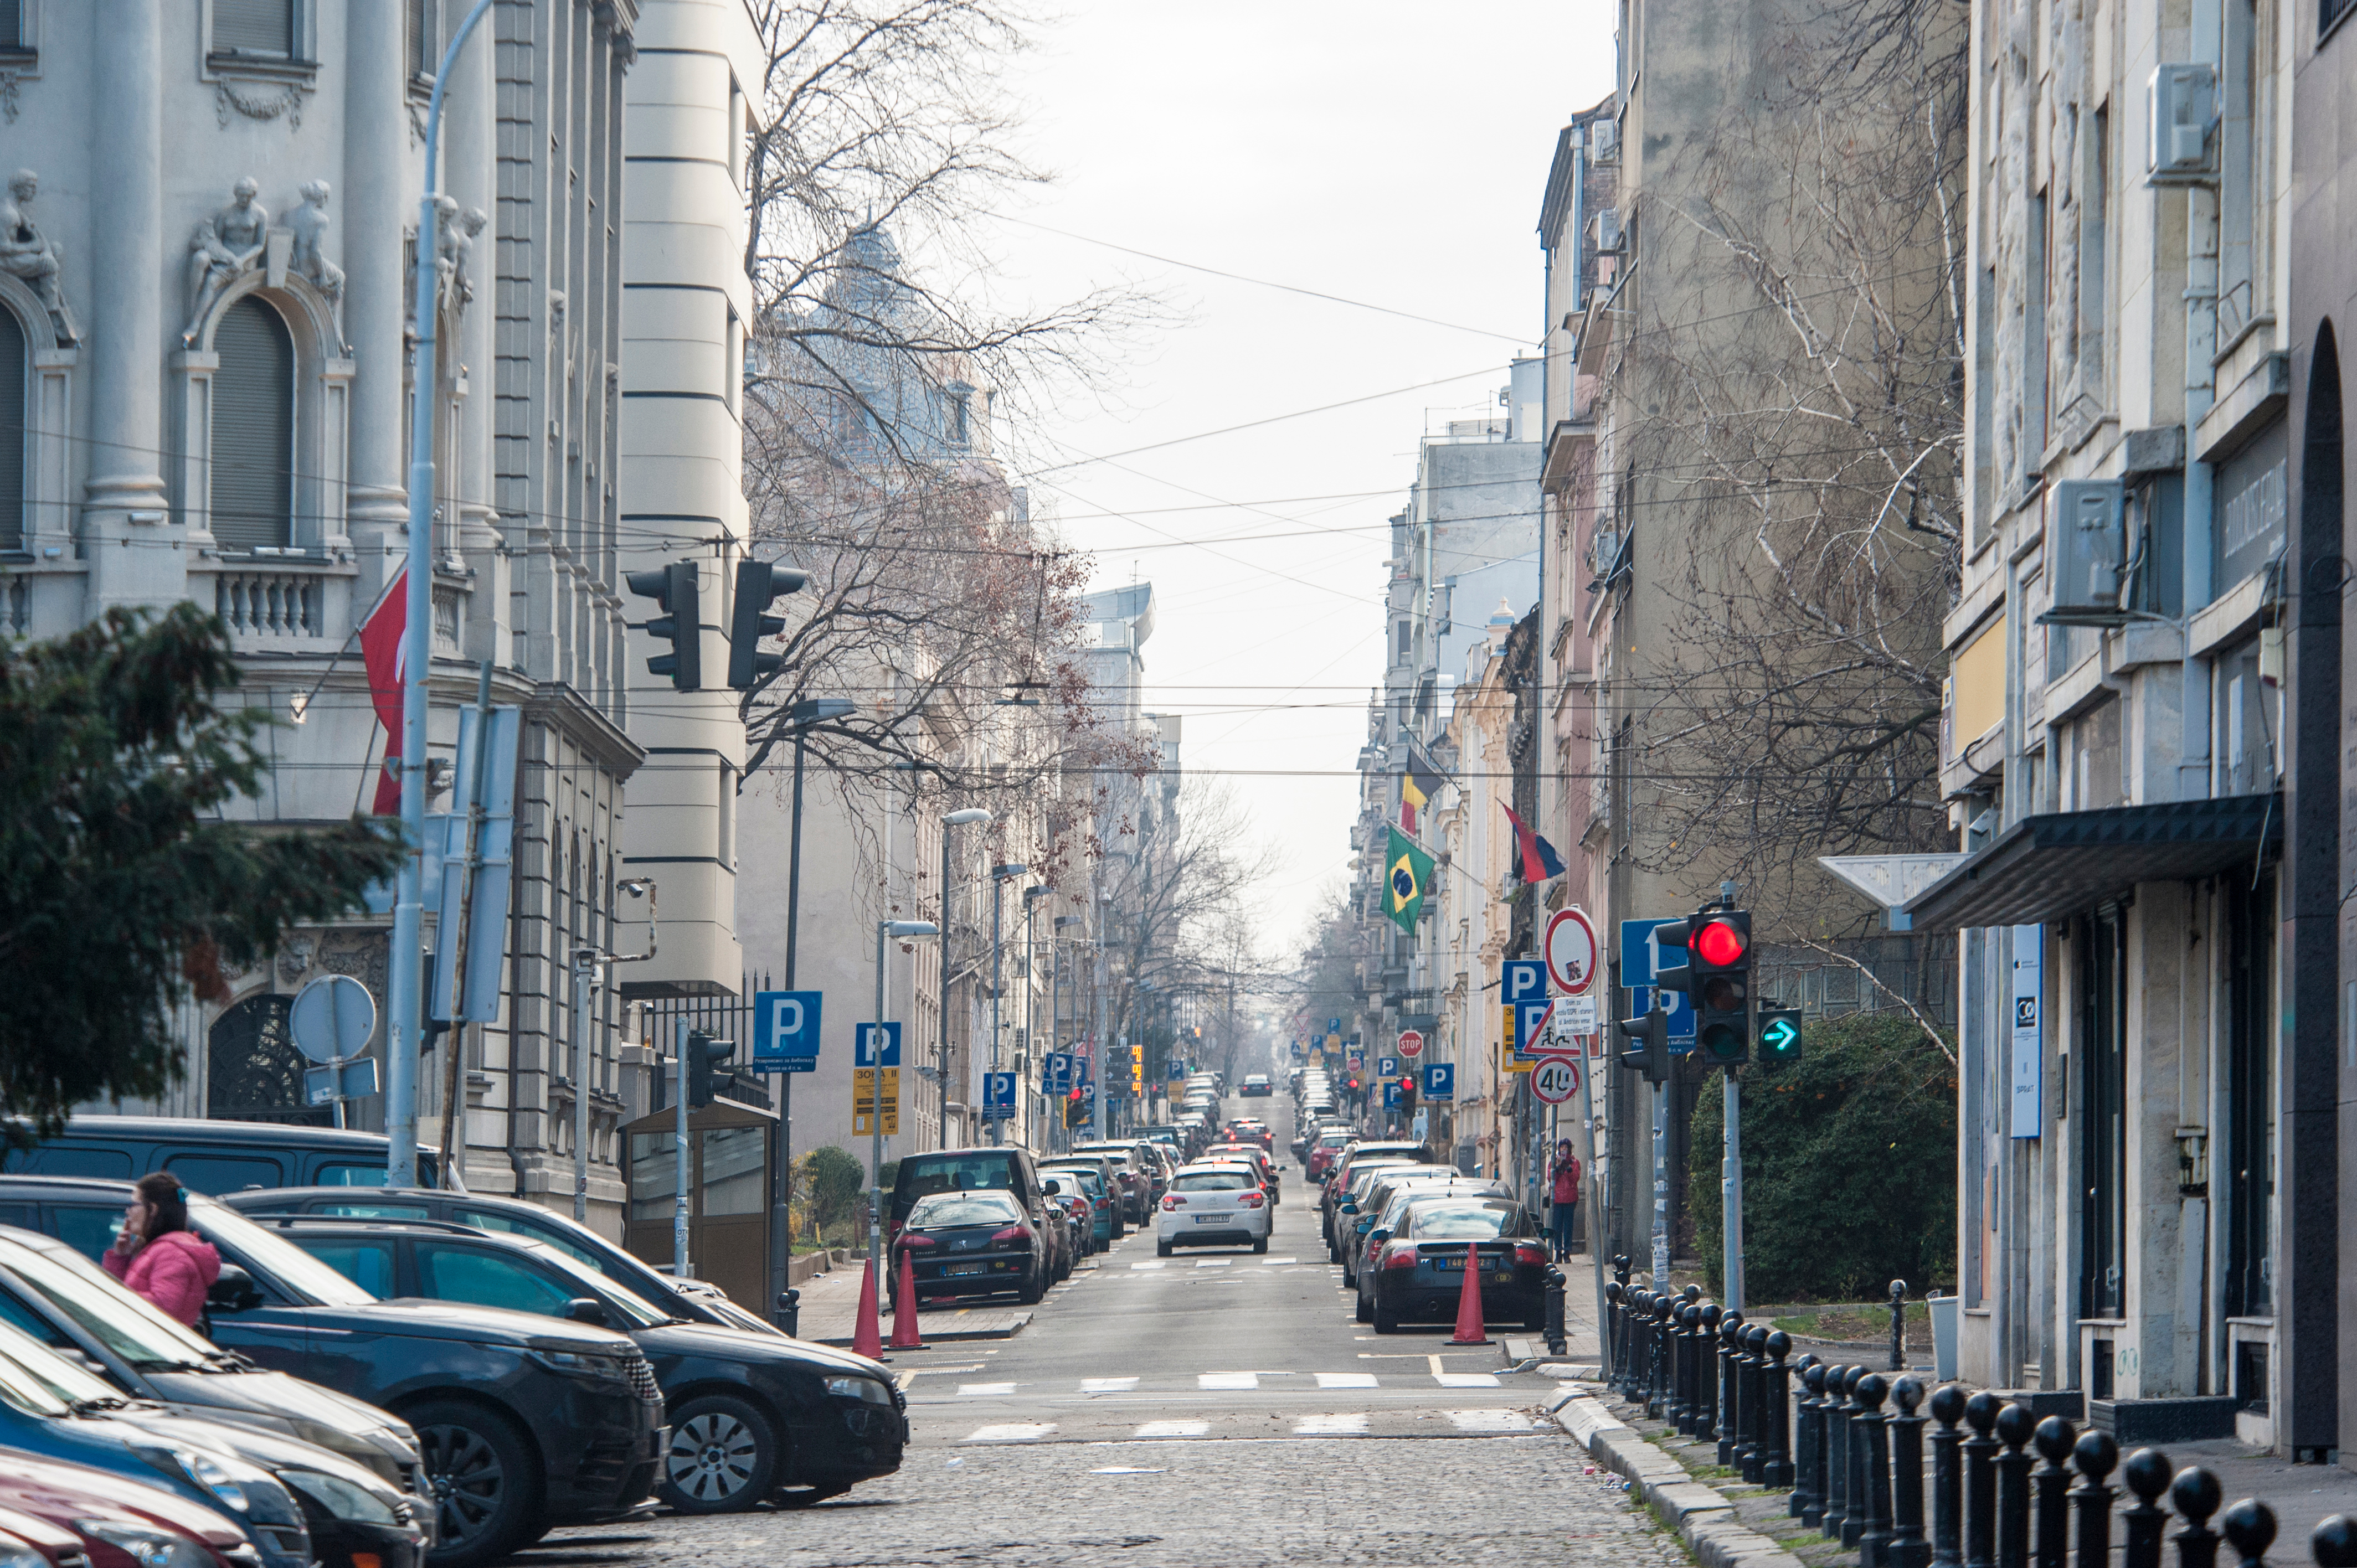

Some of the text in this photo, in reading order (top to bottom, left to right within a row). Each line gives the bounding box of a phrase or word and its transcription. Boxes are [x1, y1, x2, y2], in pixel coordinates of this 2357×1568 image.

[1512, 966, 1536, 999] P
[771, 999, 804, 1049] P
[866, 1028, 891, 1061] P
[1401, 1040, 1421, 1050] STOP
[1172, 1062, 1180, 1074] P
[1382, 1060, 1393, 1075] P
[1432, 1069, 1447, 1088] P
[2016, 1085, 2035, 1094] SPRAT
